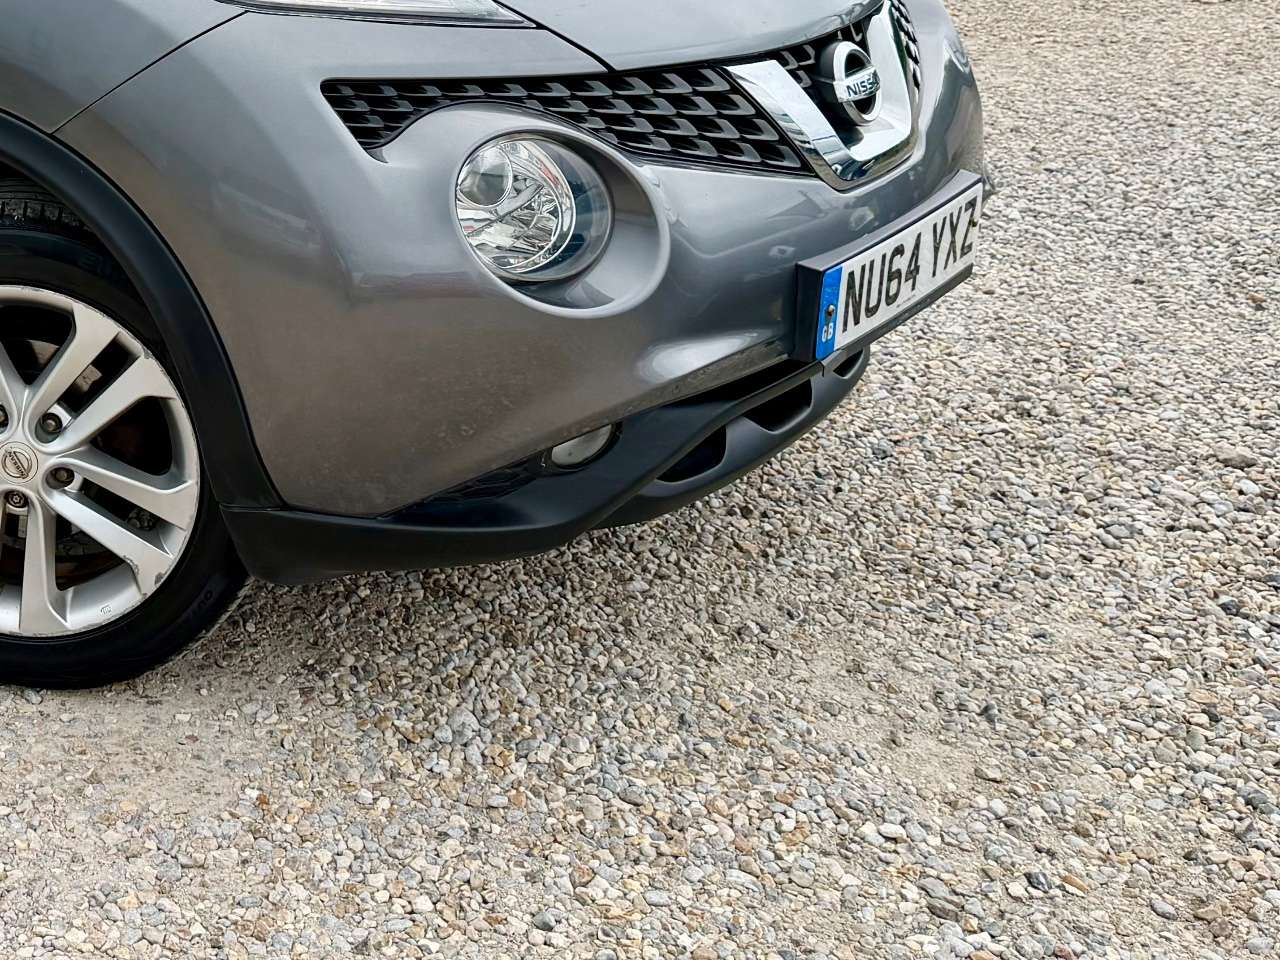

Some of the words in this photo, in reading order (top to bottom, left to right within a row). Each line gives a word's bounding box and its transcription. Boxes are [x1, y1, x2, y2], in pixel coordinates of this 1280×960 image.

[842, 231, 922, 334] NU64
[931, 195, 978, 278] YXZ
[821, 322, 834, 342] GB
